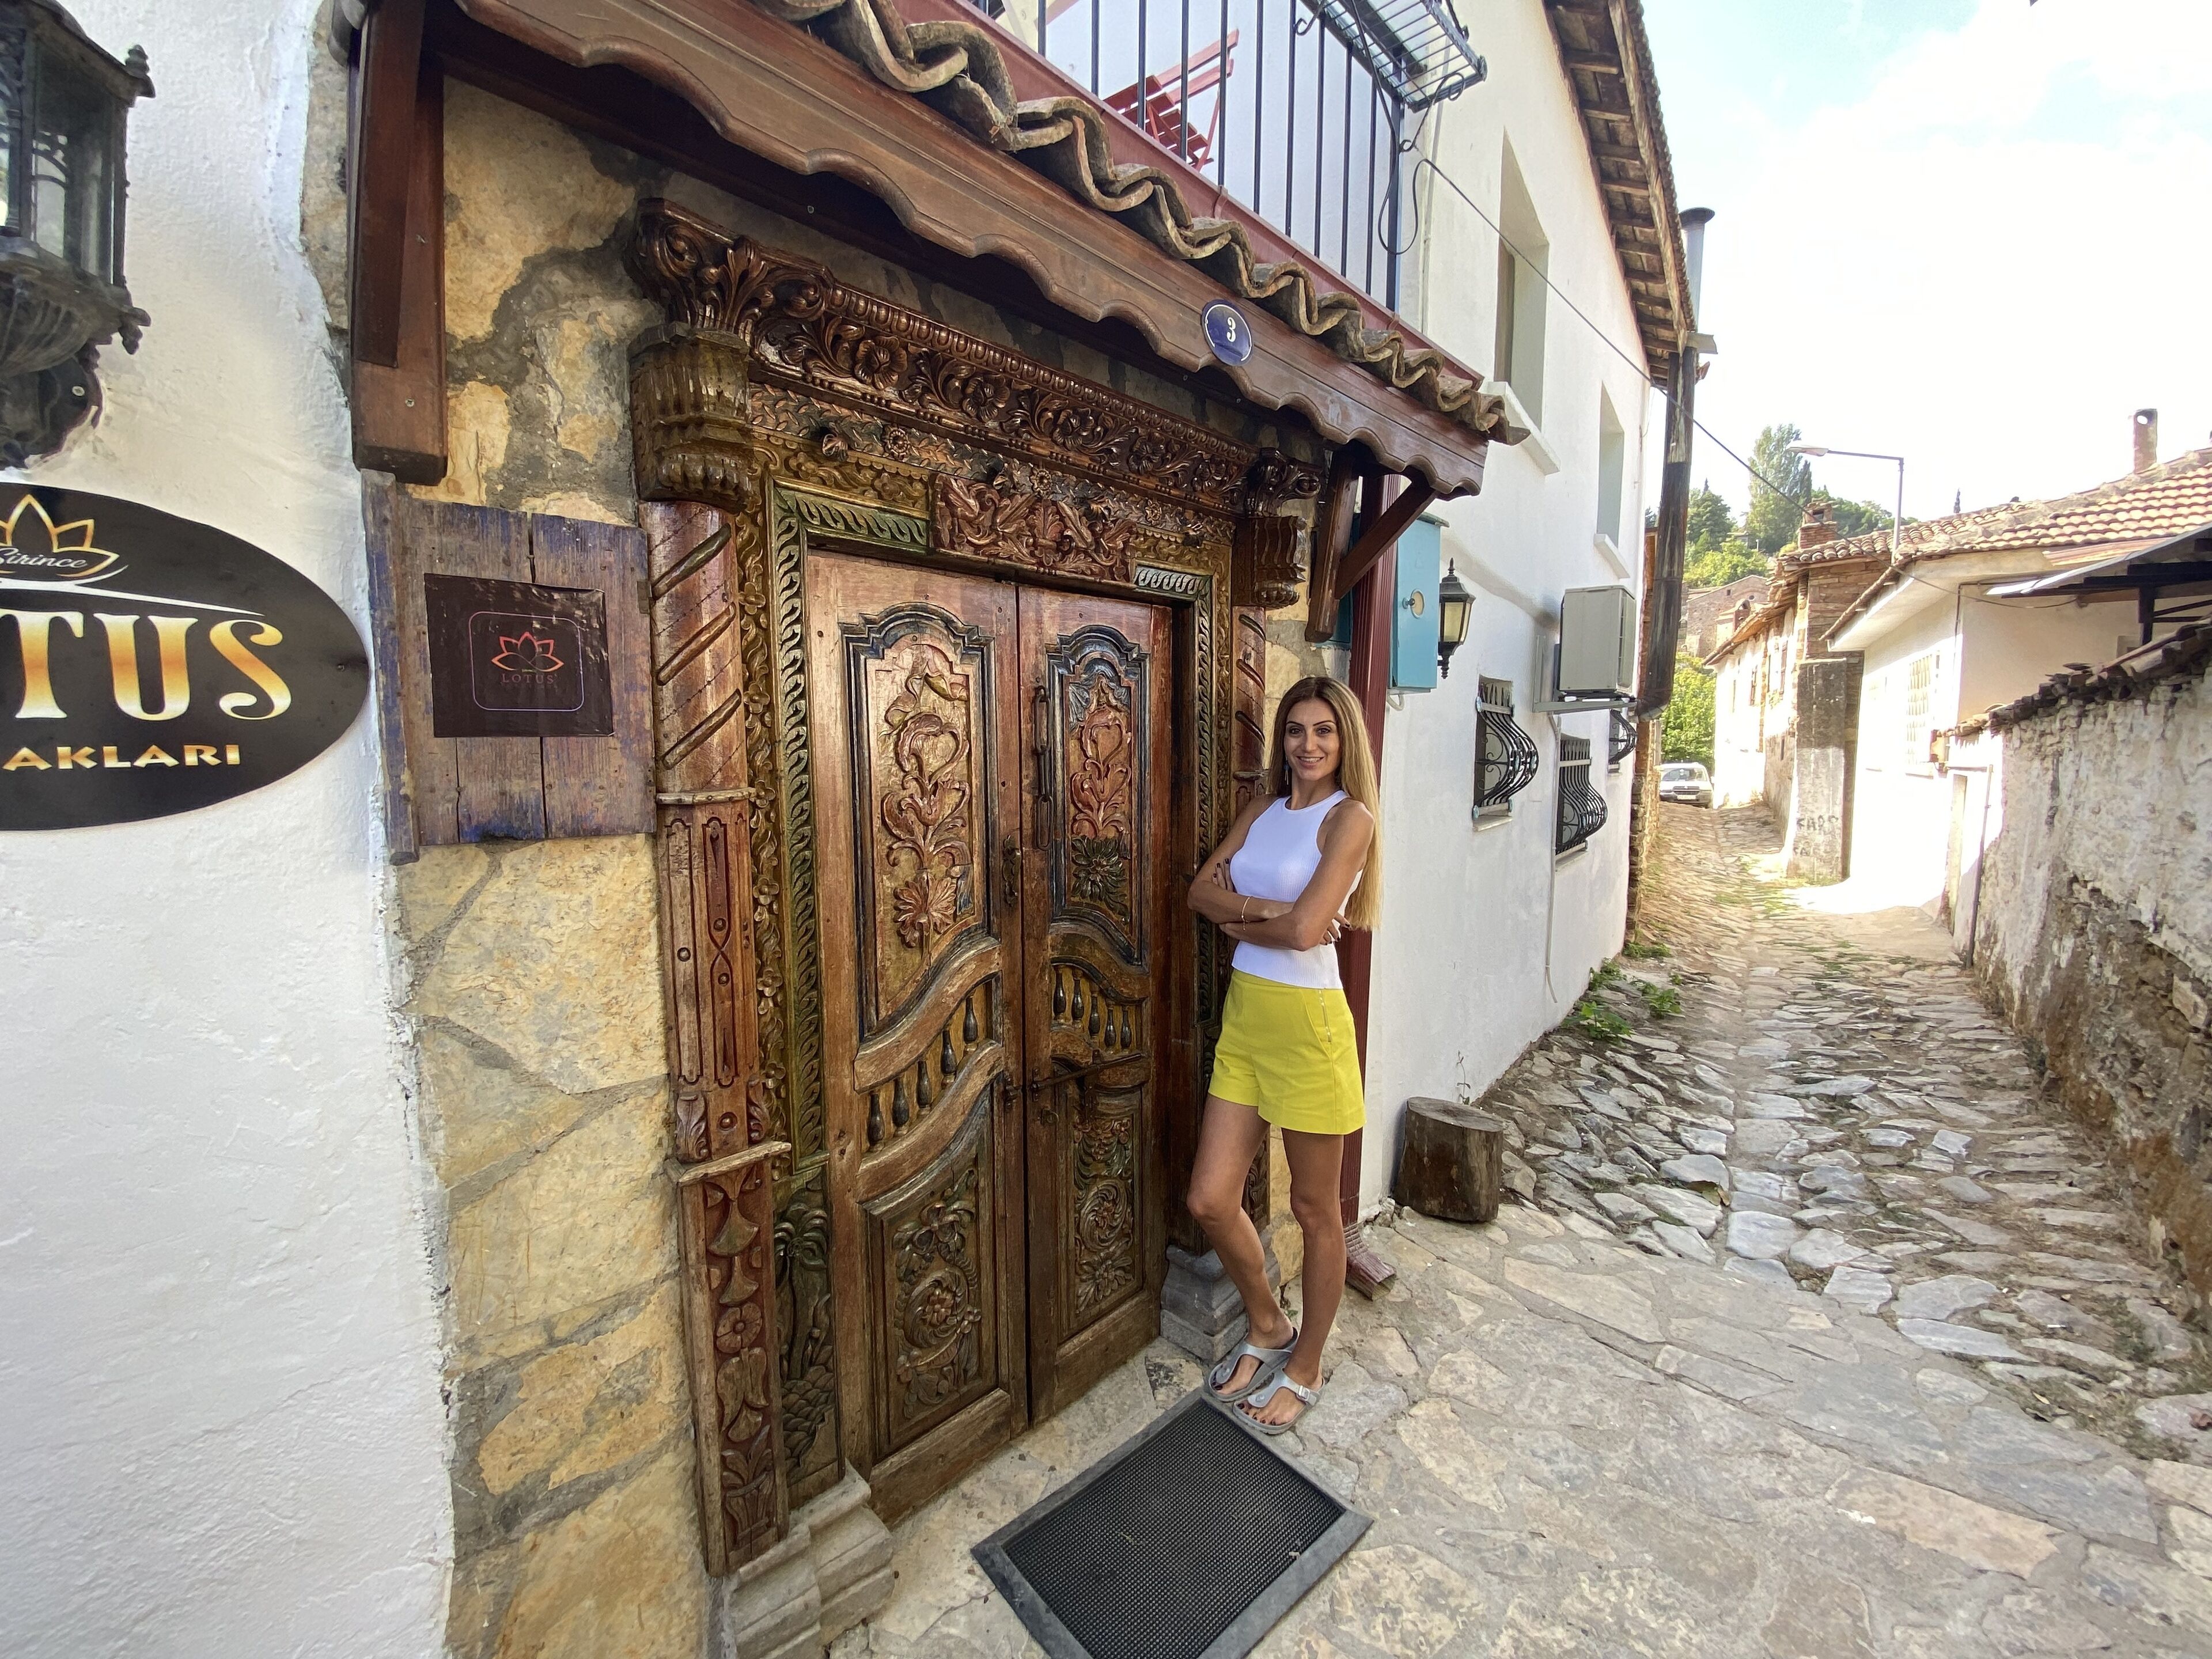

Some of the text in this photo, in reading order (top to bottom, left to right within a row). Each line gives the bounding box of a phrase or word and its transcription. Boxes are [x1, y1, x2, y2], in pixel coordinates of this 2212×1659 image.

[1226, 317, 1236, 342] 3
[502, 673, 554, 684] LOTUS
[2, 744, 241, 771] AKLARI
